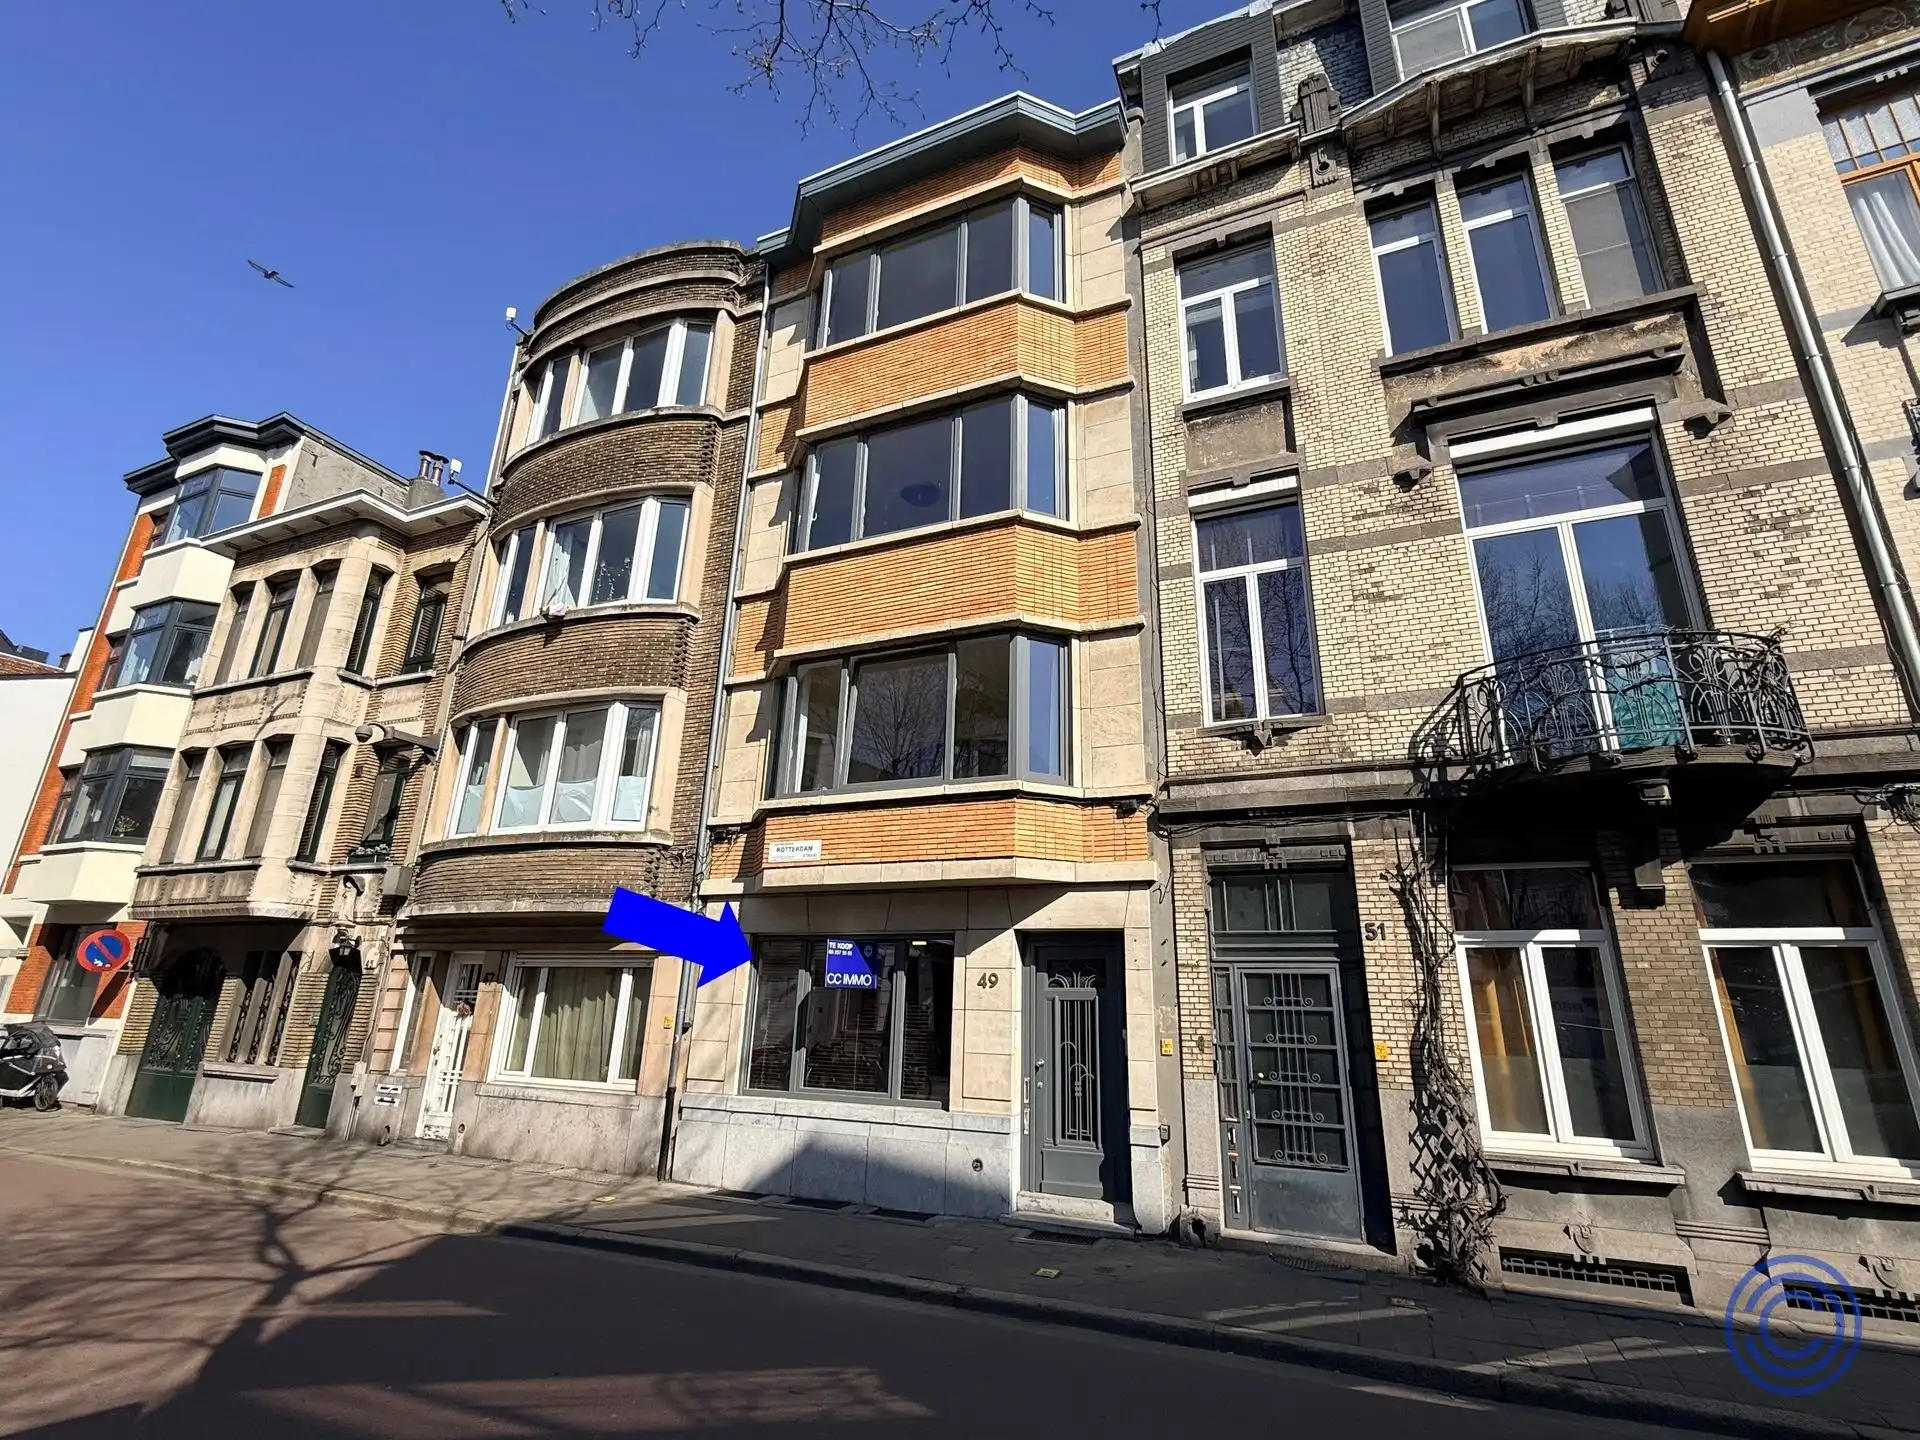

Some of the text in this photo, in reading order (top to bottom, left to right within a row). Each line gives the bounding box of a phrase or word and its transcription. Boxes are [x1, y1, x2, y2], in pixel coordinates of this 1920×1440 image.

[776, 845, 813, 853] ROTTERDAM
[1365, 922, 1386, 941] 51
[829, 941, 836, 949] TE
[827, 972, 872, 986] CC IMMO
[977, 972, 999, 989] 49
